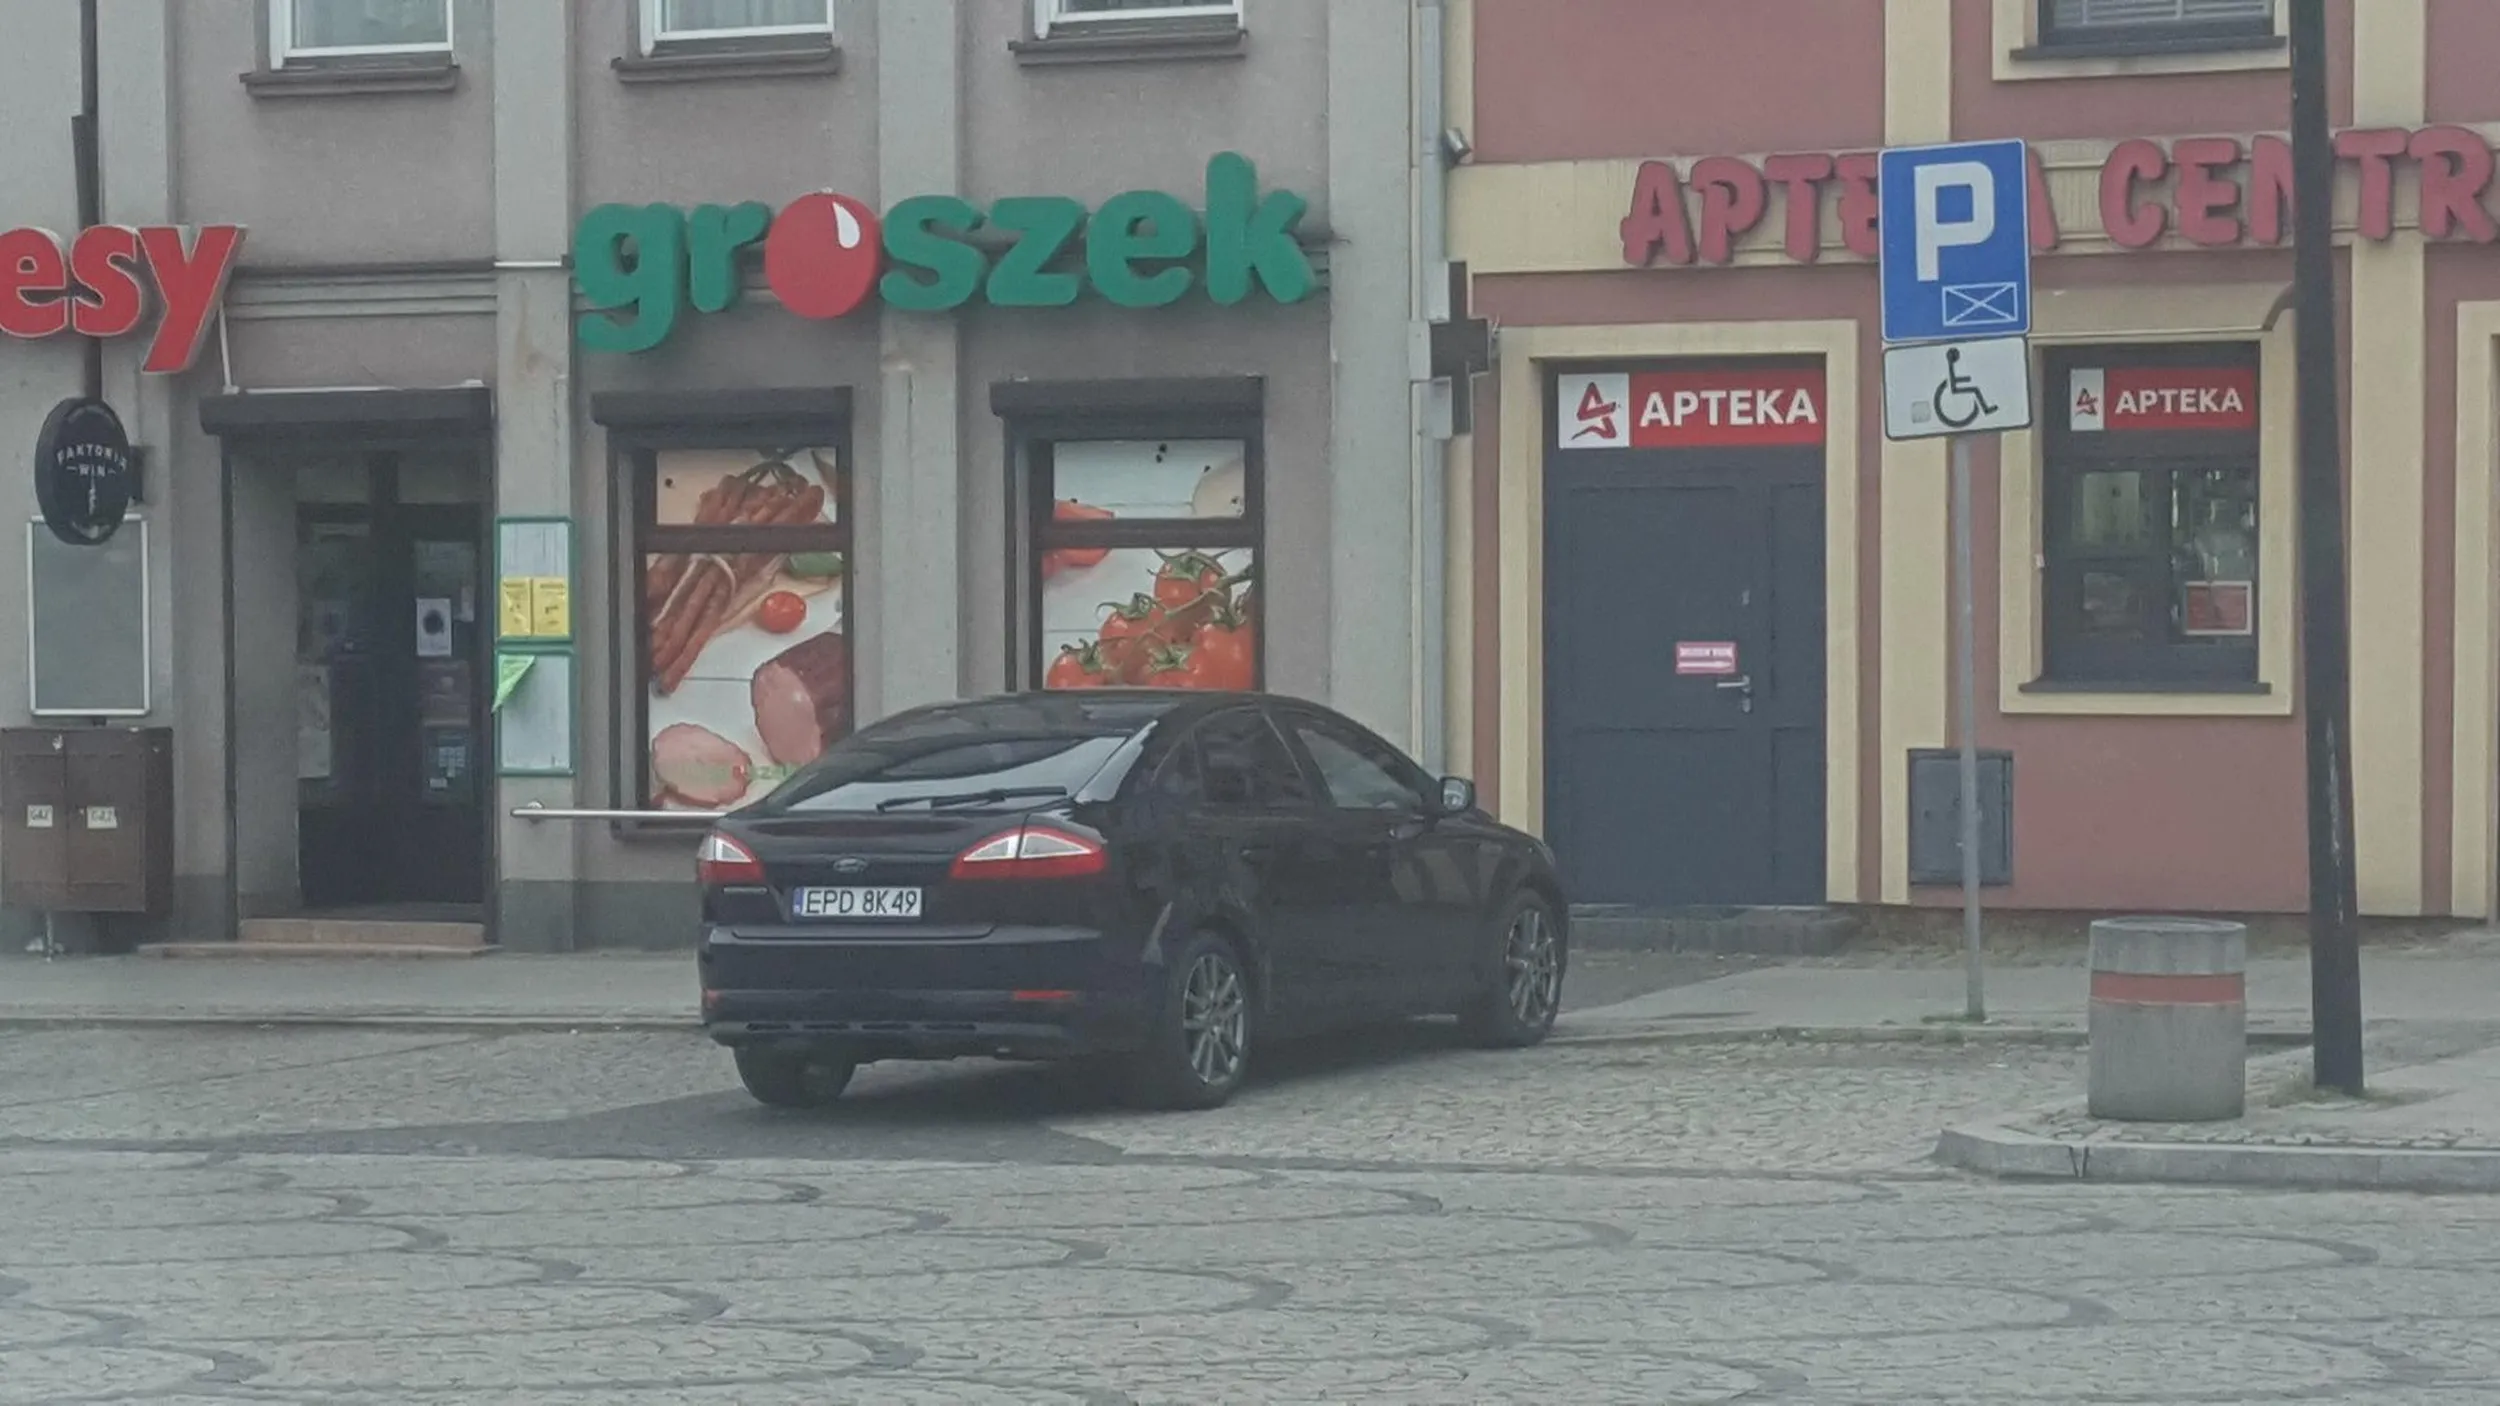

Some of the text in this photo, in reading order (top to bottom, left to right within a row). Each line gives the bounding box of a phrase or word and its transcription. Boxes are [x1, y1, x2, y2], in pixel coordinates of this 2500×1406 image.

[573, 151, 1317, 354] groszek
[1619, 147, 2057, 265] APTE
[1914, 161, 1995, 282] P
[0, 225, 244, 374] esy
[1639, 388, 1819, 428] APTEKA
[2114, 387, 2244, 415] APTEKA
[805, 889, 918, 914] EPD 8K49
